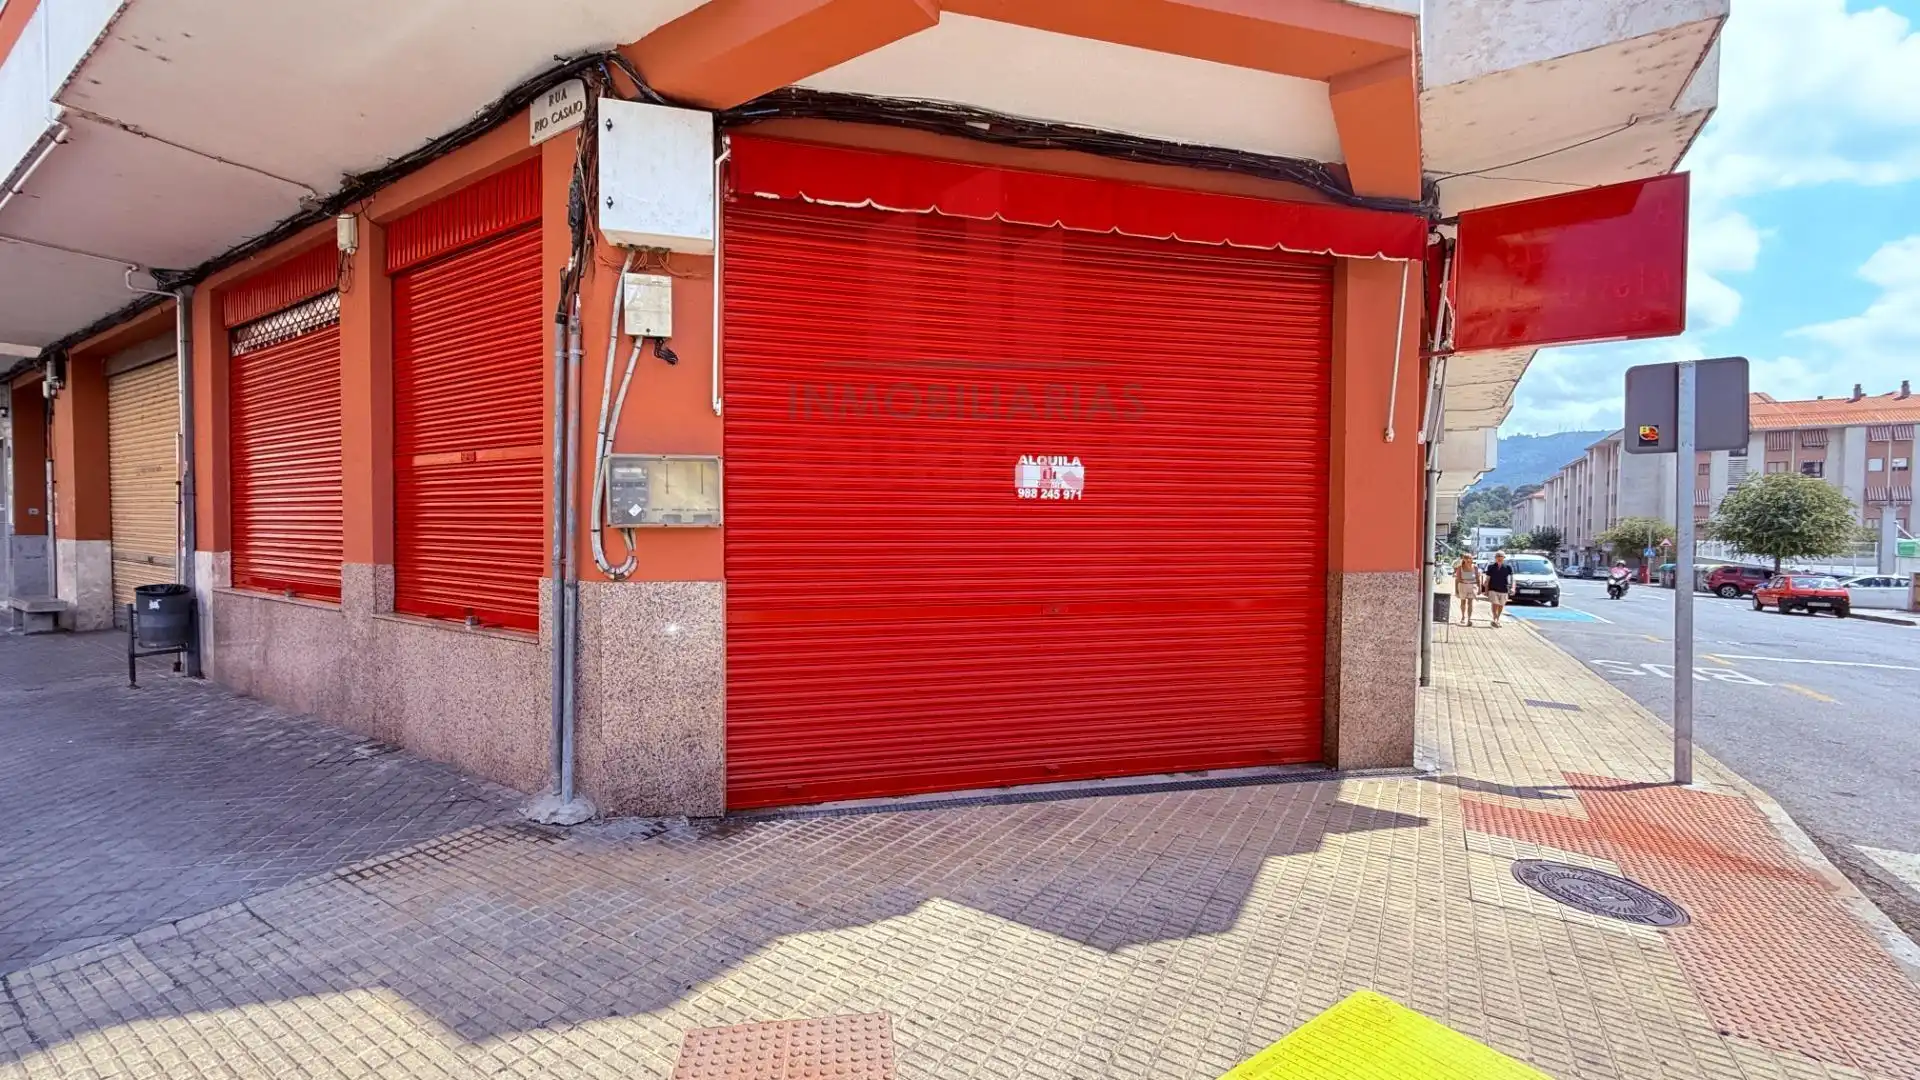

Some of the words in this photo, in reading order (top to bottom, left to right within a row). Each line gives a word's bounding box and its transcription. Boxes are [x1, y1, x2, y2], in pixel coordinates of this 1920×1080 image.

[548, 87, 568, 107] RUA
[534, 117, 549, 133] RIO
[1018, 454, 1082, 467] ALQUILA
[1018, 488, 1038, 498] 988
[1040, 489, 1060, 500] 245
[1063, 489, 1082, 500] 971
